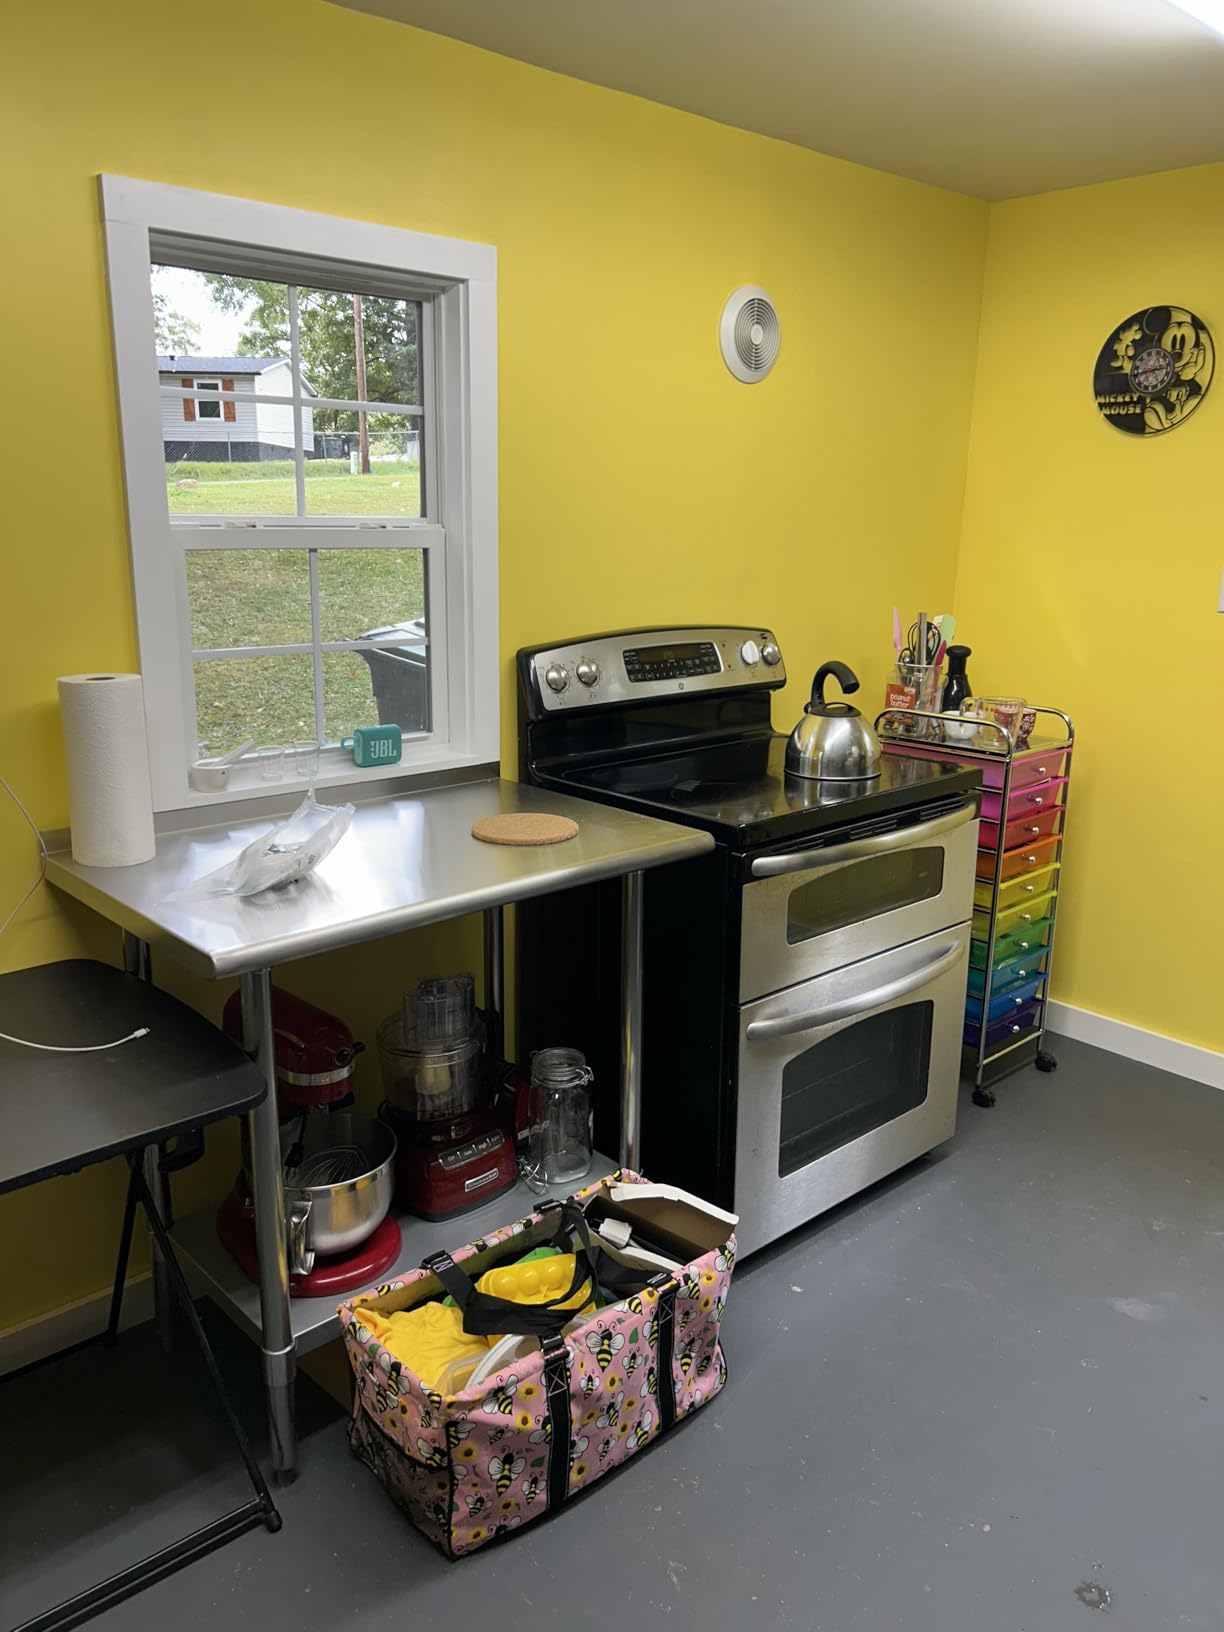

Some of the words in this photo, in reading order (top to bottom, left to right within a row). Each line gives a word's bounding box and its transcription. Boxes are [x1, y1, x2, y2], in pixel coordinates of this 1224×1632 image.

[1096, 392, 1139, 403] MICKEY
[1102, 404, 1142, 415] MOUSE
[370, 739, 397, 759] JBL
